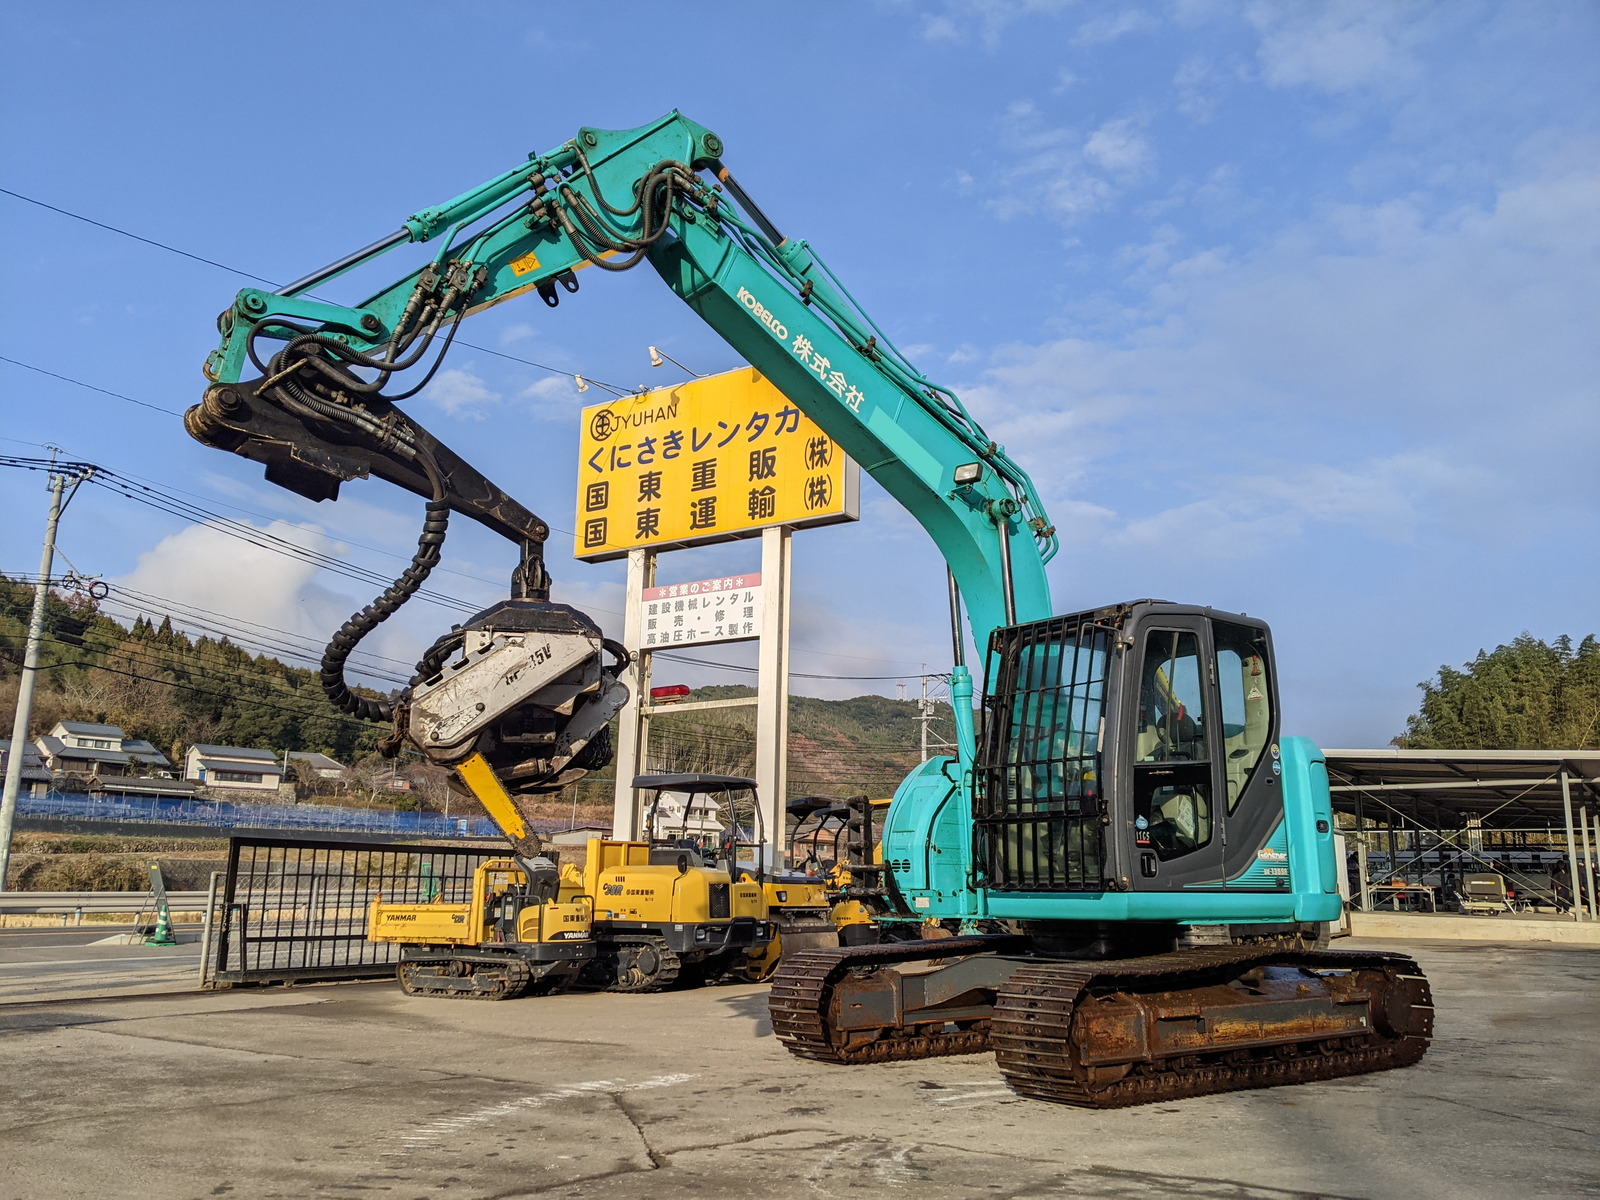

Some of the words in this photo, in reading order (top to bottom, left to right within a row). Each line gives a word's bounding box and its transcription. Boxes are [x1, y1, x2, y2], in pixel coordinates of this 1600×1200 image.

[736, 286, 789, 340] KOBELCO
[792, 333, 865, 414] 株式会社
[610, 403, 678, 433] JYUHAN
[588, 405, 809, 473] くにさきレンタカ
[648, 590, 754, 616] 建設機械レンタル
[646, 621, 753, 646] 高油圧ホース製作
[386, 914, 416, 922] YANMAR
